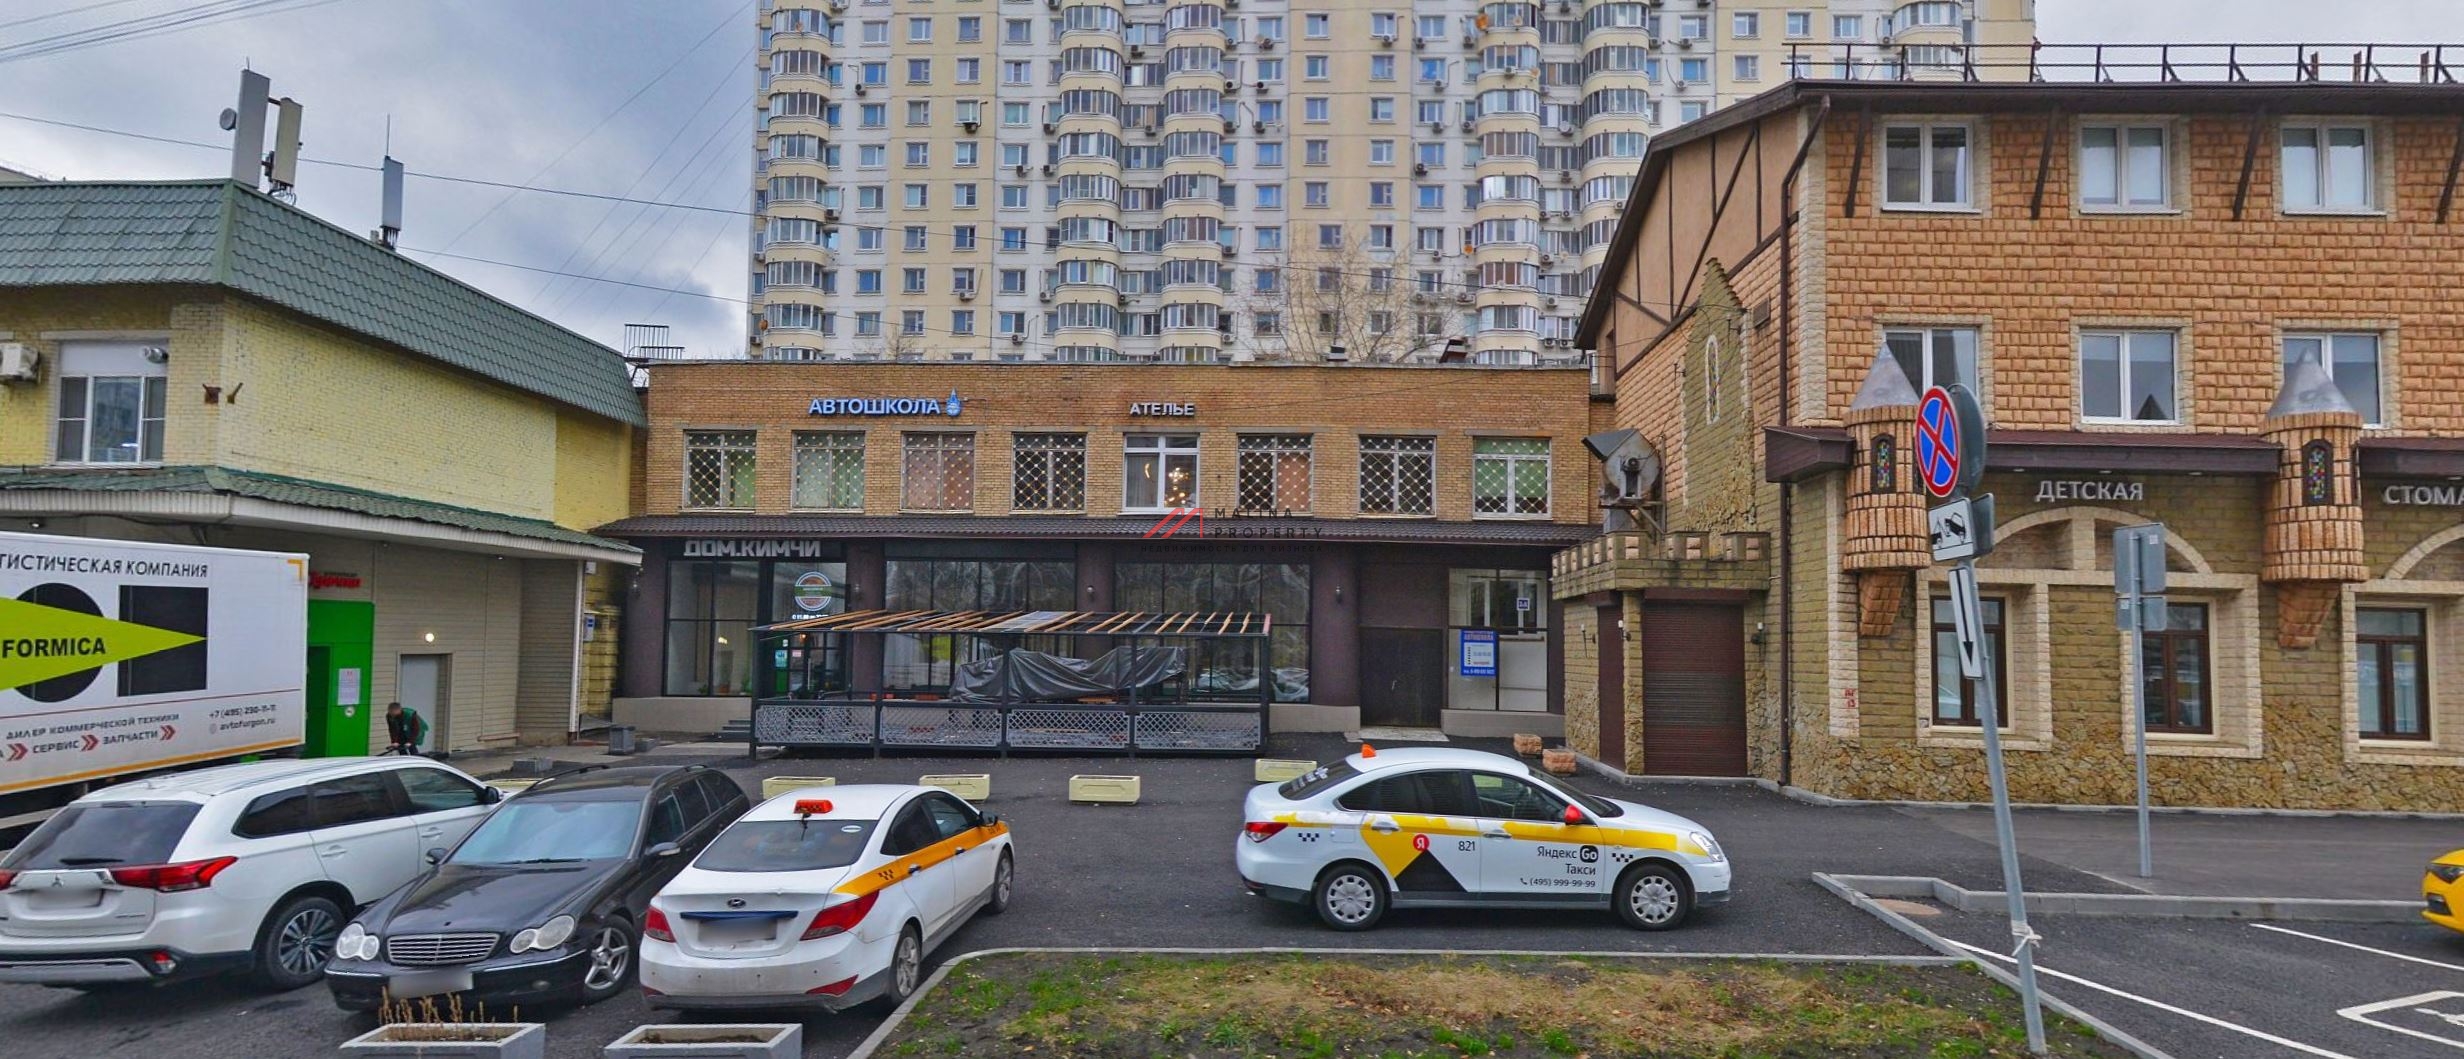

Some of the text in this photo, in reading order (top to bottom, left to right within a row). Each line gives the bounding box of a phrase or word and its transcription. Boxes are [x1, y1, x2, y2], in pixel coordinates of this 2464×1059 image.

[808, 398, 941, 415] АВТОШКОЛА
[1129, 402, 1195, 416] АТЕЛЬЕ
[2035, 480, 2144, 502] ДЕТСКАЯ
[683, 540, 821, 557] ДОМ.КИМЧИ
[125, 560, 208, 578] КОМПАНИЯ
[2, 637, 106, 658] FORMICA
[6, 713, 180, 739] ДИЛЕР КОММЕРЧЕСКОЙ ТЕХНИКИ
[219, 718, 276, 731] avtofurgon.ru
[33, 730, 159, 754] СЕРВИС ЗАПЧАСТИ
[1458, 840, 1476, 851] 821
[1537, 846, 1598, 860] Яндекс Go
[1565, 863, 1596, 875] Такси
[1529, 878, 1596, 888] (495) 999-99-99
